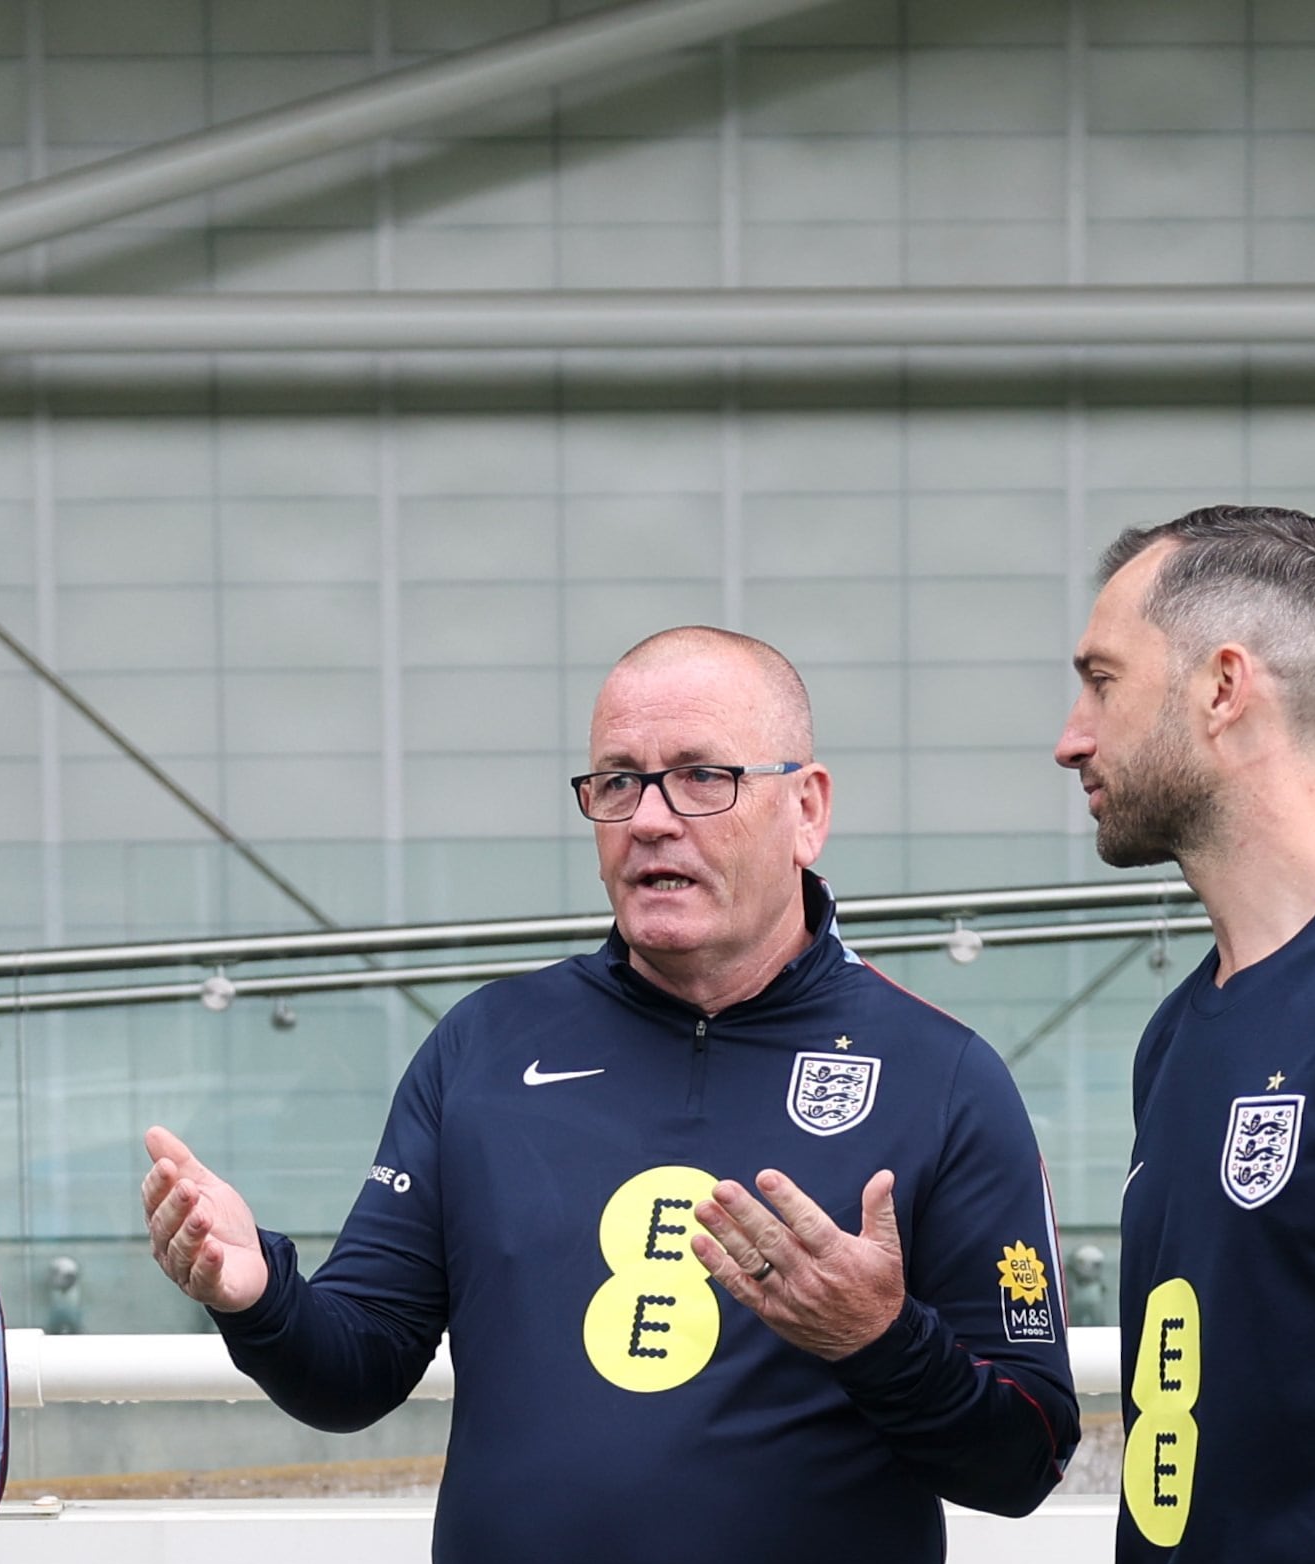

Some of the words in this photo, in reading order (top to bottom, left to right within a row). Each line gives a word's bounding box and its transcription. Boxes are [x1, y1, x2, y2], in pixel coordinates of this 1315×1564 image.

[1010, 1256, 1032, 1271] eat
[1012, 1268, 1039, 1285] well
[1011, 1308, 1049, 1328] M&S
